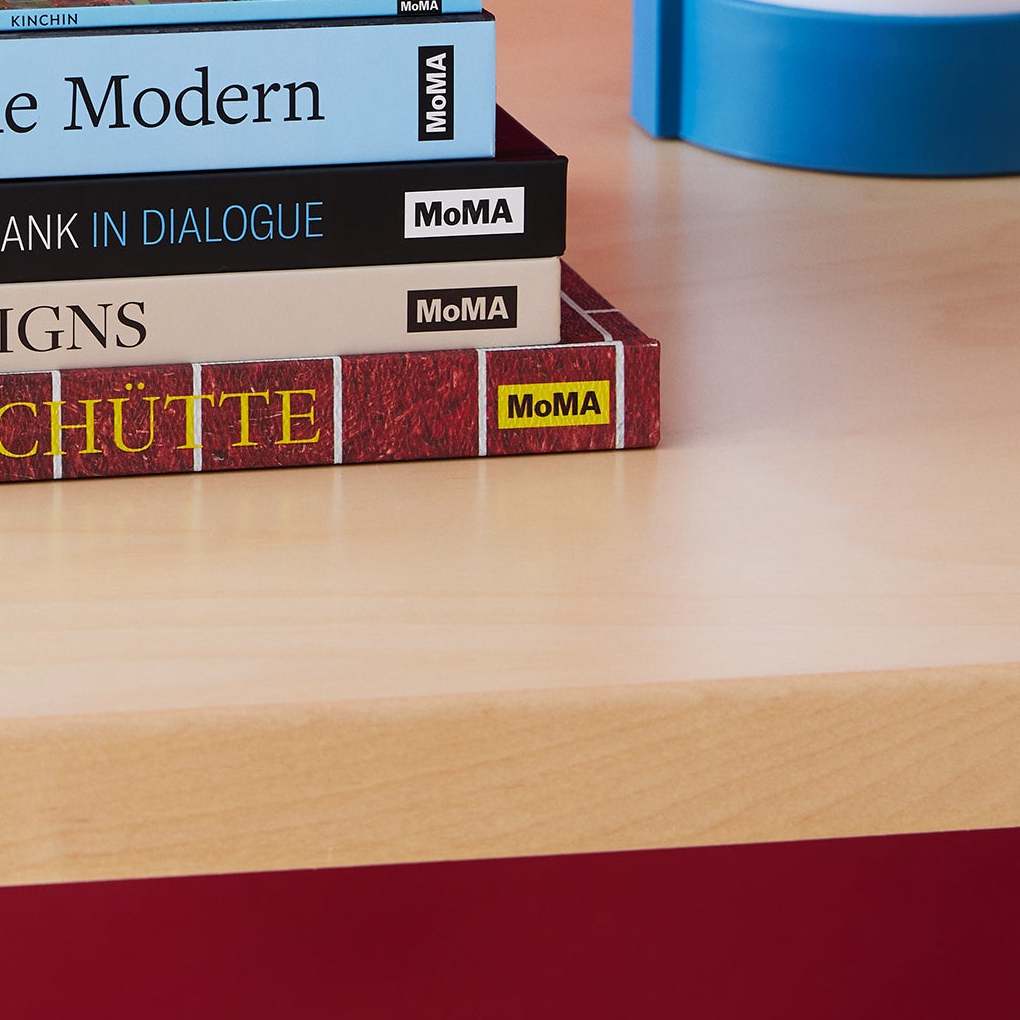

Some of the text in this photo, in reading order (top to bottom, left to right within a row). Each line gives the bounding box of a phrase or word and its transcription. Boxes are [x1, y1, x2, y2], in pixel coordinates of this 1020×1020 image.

[10, 13, 78, 27] KINCHIN
[400, 0, 439, 13] MoMA
[63, 66, 326, 132] Modern
[425, 52, 447, 133] MoMA
[91, 210, 128, 248] IN
[141, 201, 325, 245] DIALOGUE
[414, 198, 514, 228] MoMA
[416, 296, 510, 324] MoMA
[507, 391, 602, 420] MoMA
